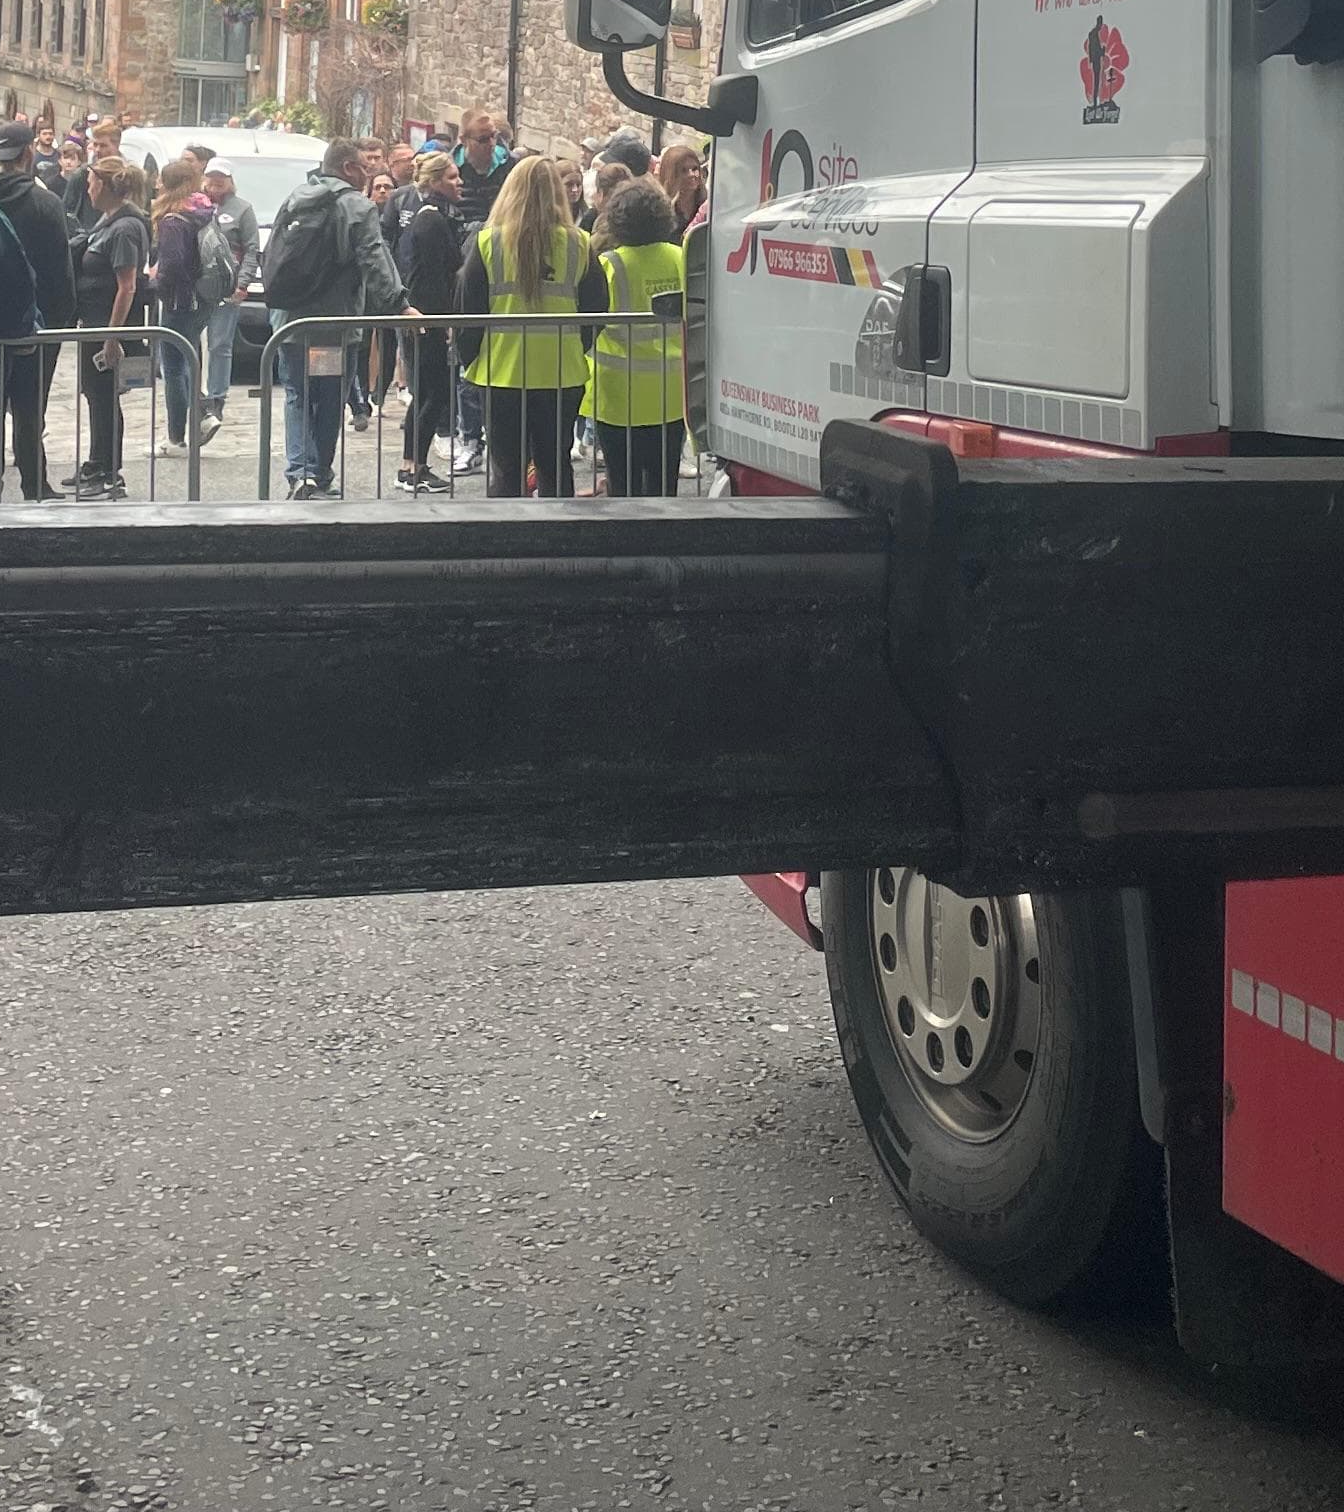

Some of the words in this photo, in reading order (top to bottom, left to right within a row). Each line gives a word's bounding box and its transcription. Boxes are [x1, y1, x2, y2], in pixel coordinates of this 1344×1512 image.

[817, 142, 858, 192] site
[768, 248, 794, 268] 07966
[795, 251, 828, 274] 966353
[720, 379, 760, 406] QUEENSWAY
[761, 391, 796, 418] BUSINESS
[797, 402, 821, 424] PARK
[731, 405, 762, 426] HAWTHORNE
[774, 419, 796, 437] BOOTLE
